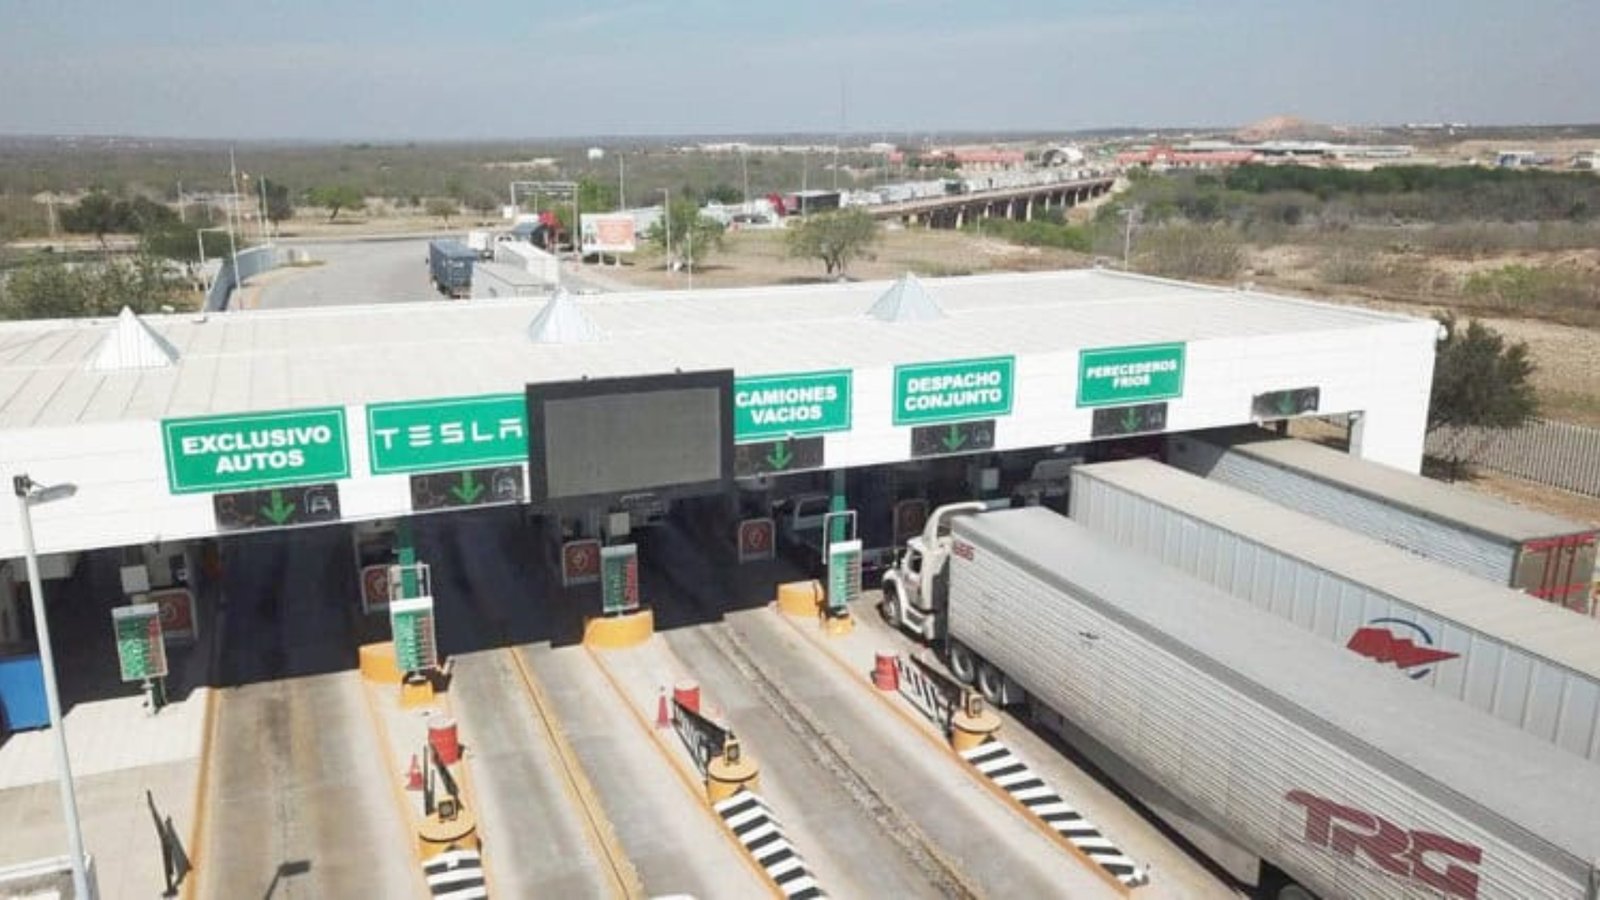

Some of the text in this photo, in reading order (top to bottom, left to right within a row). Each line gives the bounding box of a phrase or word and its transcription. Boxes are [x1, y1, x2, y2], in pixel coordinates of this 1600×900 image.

[1086, 359, 1177, 378] PERECEDEROS
[907, 371, 1000, 393] DESPACHO
[1113, 375, 1151, 389] FRIOS
[735, 385, 838, 407] CAMIONES
[904, 388, 1001, 412] CONJUNTO
[752, 404, 822, 425] VACIOS
[182, 425, 331, 455] EXCLUSIVO
[375, 418, 523, 450] TESLA
[216, 449, 305, 474] AUTOS
[1285, 788, 1483, 900] TRG
